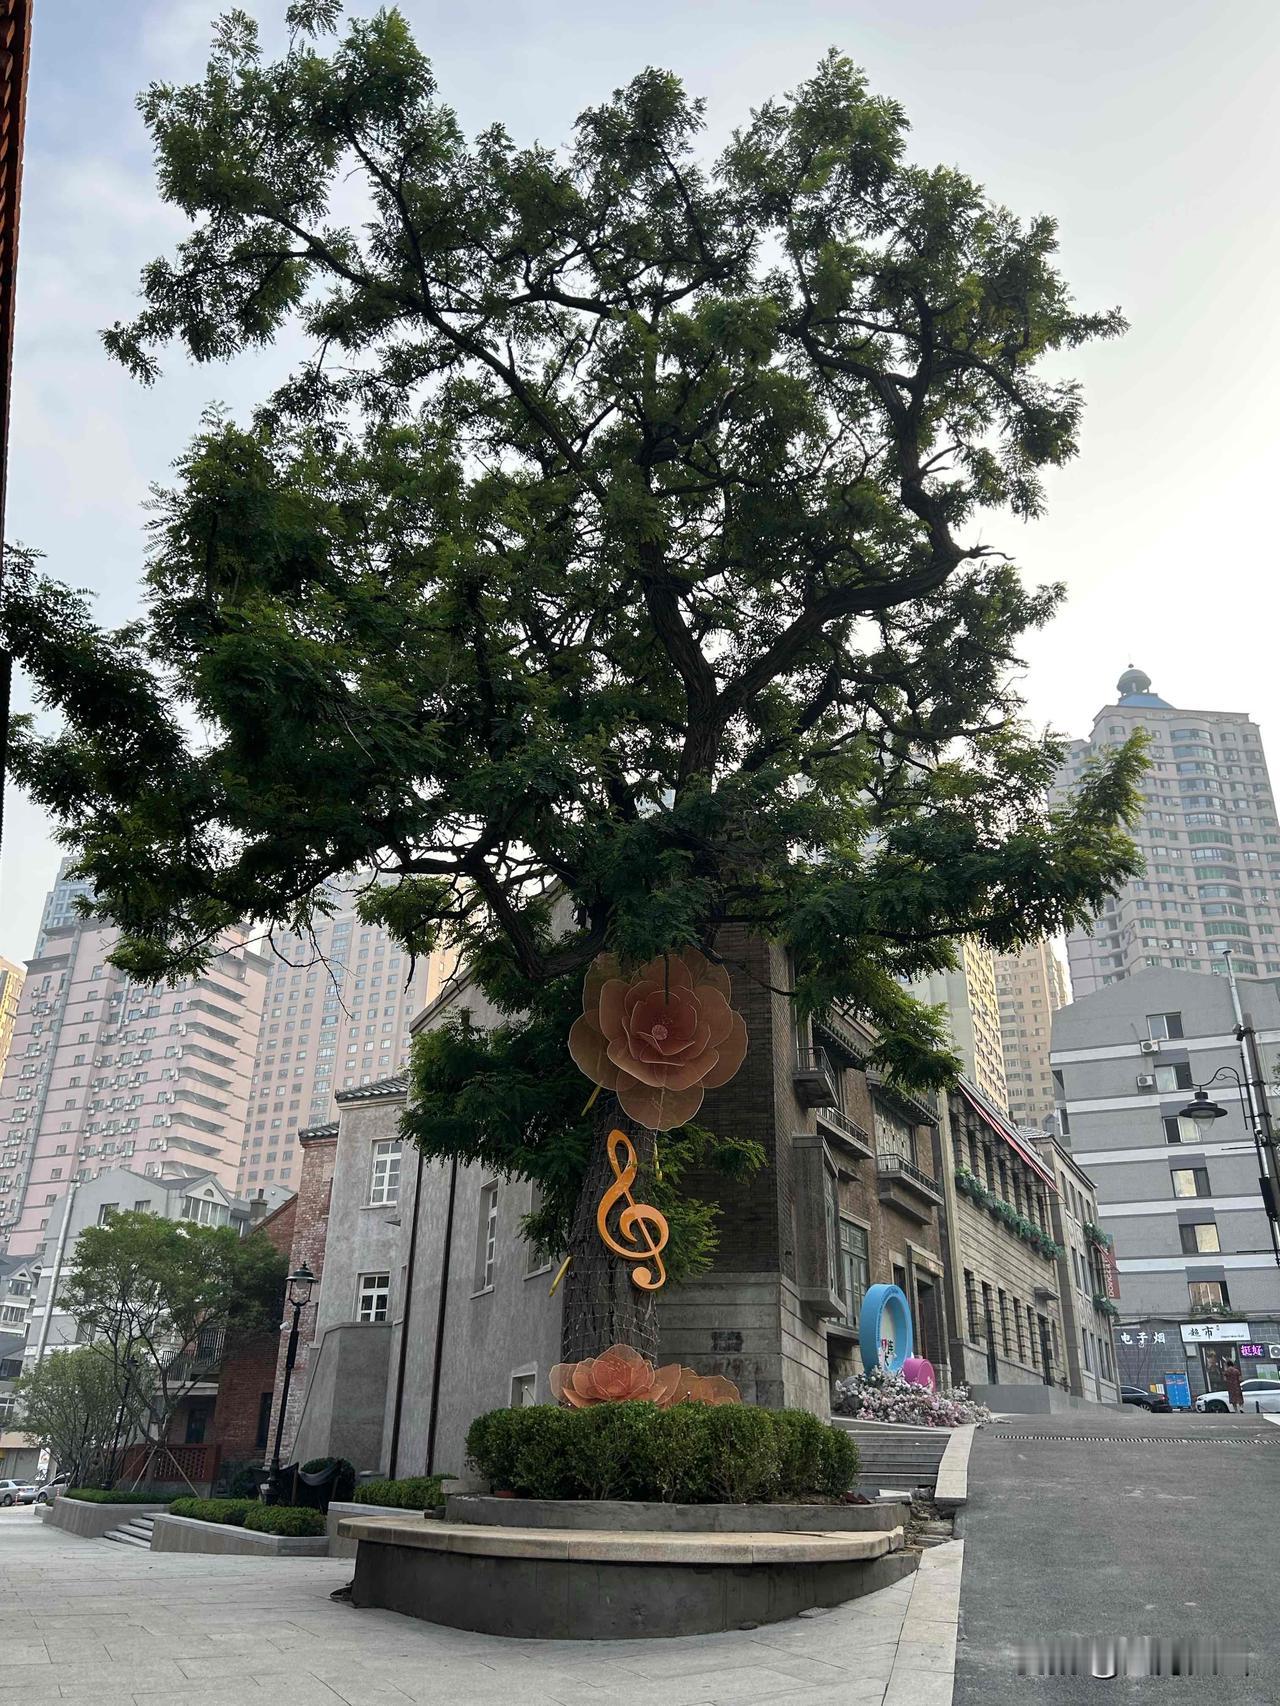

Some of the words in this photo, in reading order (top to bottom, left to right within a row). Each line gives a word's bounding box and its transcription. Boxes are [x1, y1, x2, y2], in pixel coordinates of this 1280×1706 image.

[1120, 1331, 1166, 1346] 电子烟
[1187, 1325, 1214, 1340] 超市
